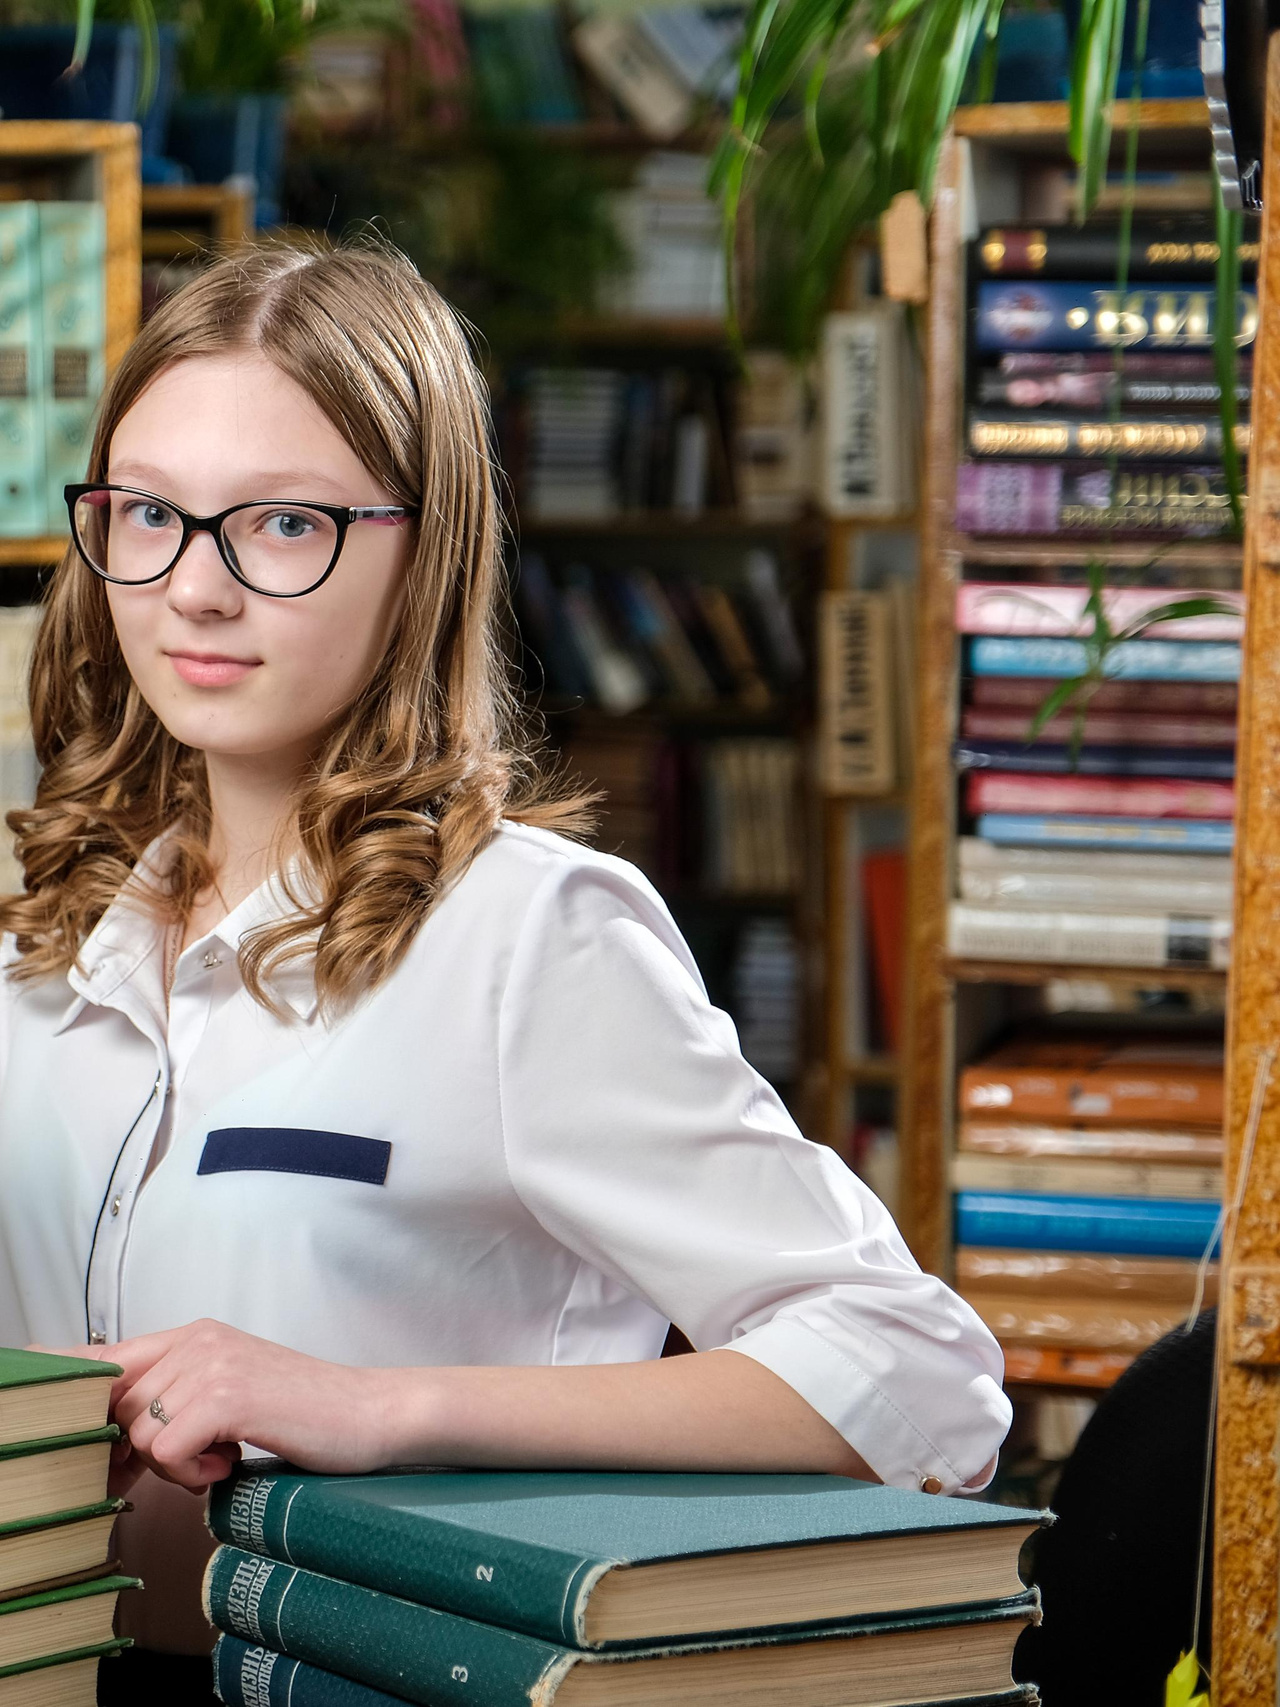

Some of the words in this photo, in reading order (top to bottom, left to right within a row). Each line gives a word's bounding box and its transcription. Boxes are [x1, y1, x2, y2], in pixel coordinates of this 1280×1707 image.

[230, 1475, 259, 1550] ЖИЗНЬ
[226, 1557, 261, 1636] ЖИЗНЬ
[245, 1561, 276, 1642] ЖИВОТНЫХ
[476, 1565, 494, 1582] 2
[257, 1649, 280, 1707] ВОТНЫХ
[451, 1665, 469, 1683] 3
